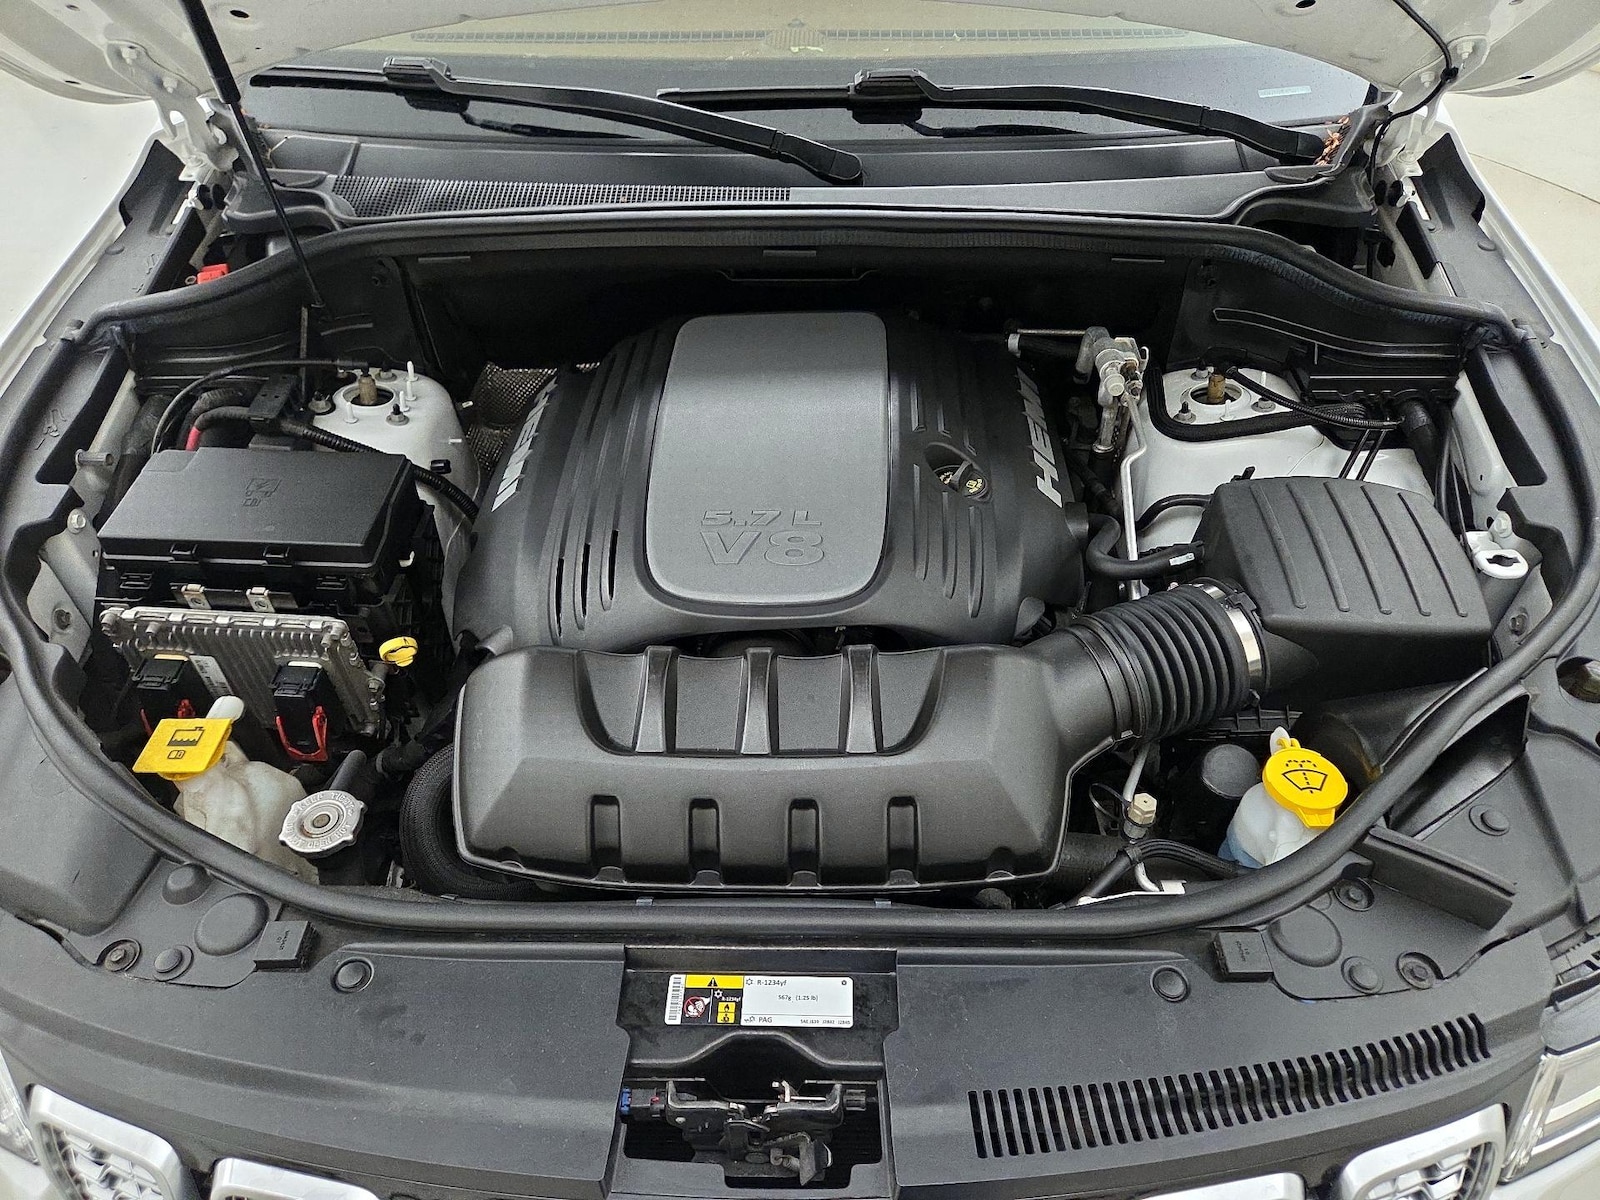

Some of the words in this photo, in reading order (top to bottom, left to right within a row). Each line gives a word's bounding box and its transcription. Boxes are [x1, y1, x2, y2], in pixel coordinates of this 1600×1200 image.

[1014, 366, 1063, 508] HEMI
[701, 510, 782, 527] 5.7
[792, 510, 823, 527] L
[699, 531, 826, 567] V8
[756, 979, 787, 987] R-1234yf
